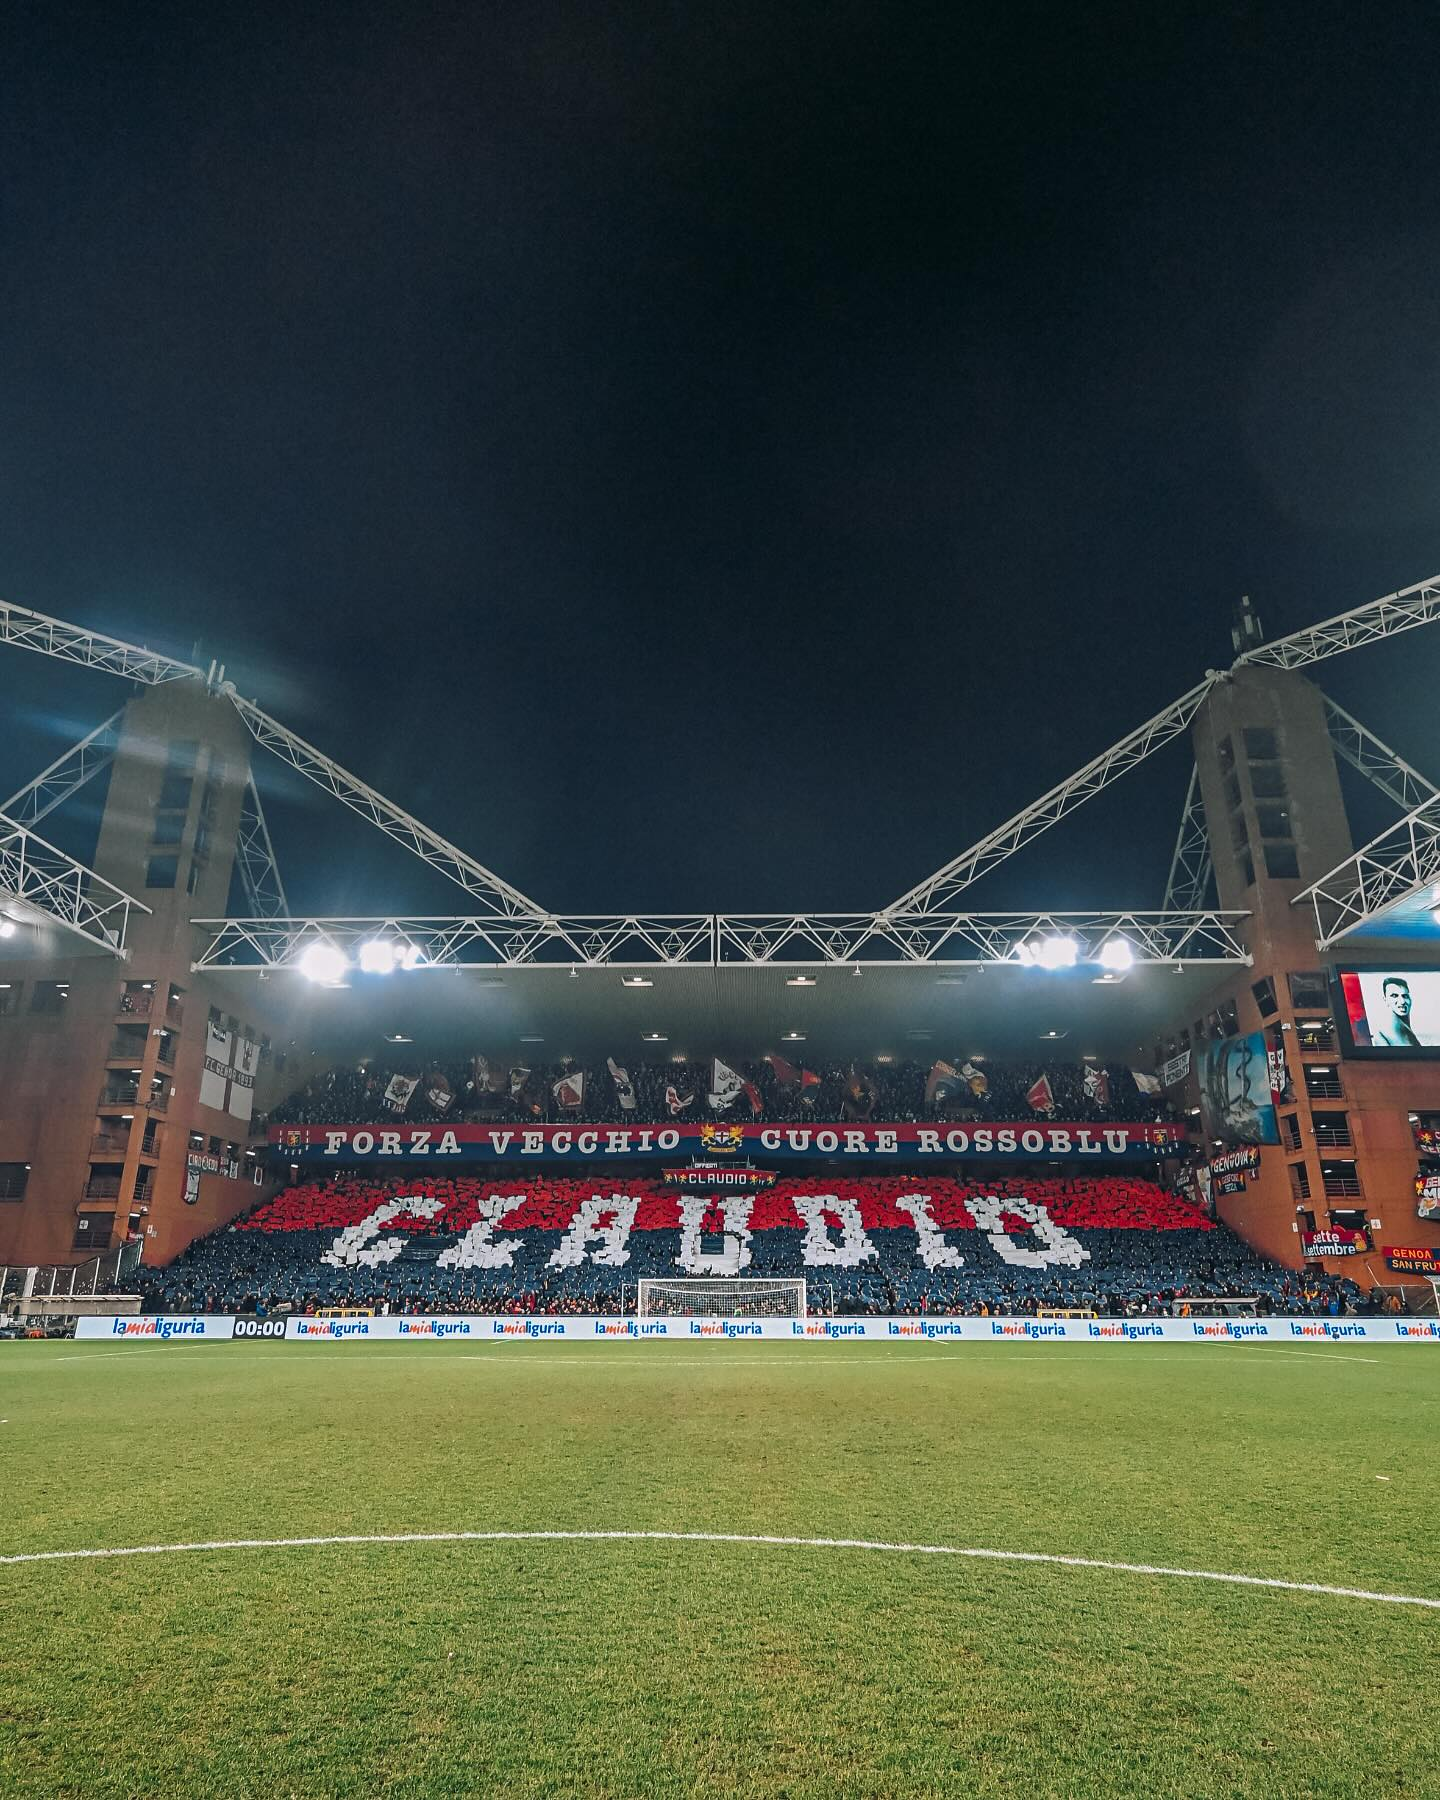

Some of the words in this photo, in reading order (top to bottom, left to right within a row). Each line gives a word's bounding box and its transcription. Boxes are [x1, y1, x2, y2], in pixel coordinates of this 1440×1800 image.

[324, 1131, 462, 1154] FORZA
[488, 1129, 680, 1154] VECCHIO
[760, 1129, 897, 1152] CUORE
[917, 1129, 1129, 1152] ROSSOBLU
[688, 1173, 747, 1184] CLAUDIO
[320, 1195, 1091, 1276] CLAUDIO
[1313, 1230, 1340, 1243] sette
[1307, 1243, 1356, 1256] settembre
[1392, 1249, 1432, 1259] GENOA
[1392, 1260, 1413, 1270] SAN
[112, 1318, 205, 1338] lamialiguria
[235, 1321, 285, 1336] 00:00
[297, 1321, 369, 1337] lamialiguria
[399, 1321, 471, 1337] lamialiguria
[493, 1320, 565, 1336] lamialiguria
[690, 1320, 763, 1337] lamialiguria
[888, 1321, 962, 1338] lamialiguria
[991, 1321, 1066, 1338] lamialiguria
[1088, 1322, 1164, 1339] lamialiguria
[1193, 1322, 1268, 1339] lamialiguria
